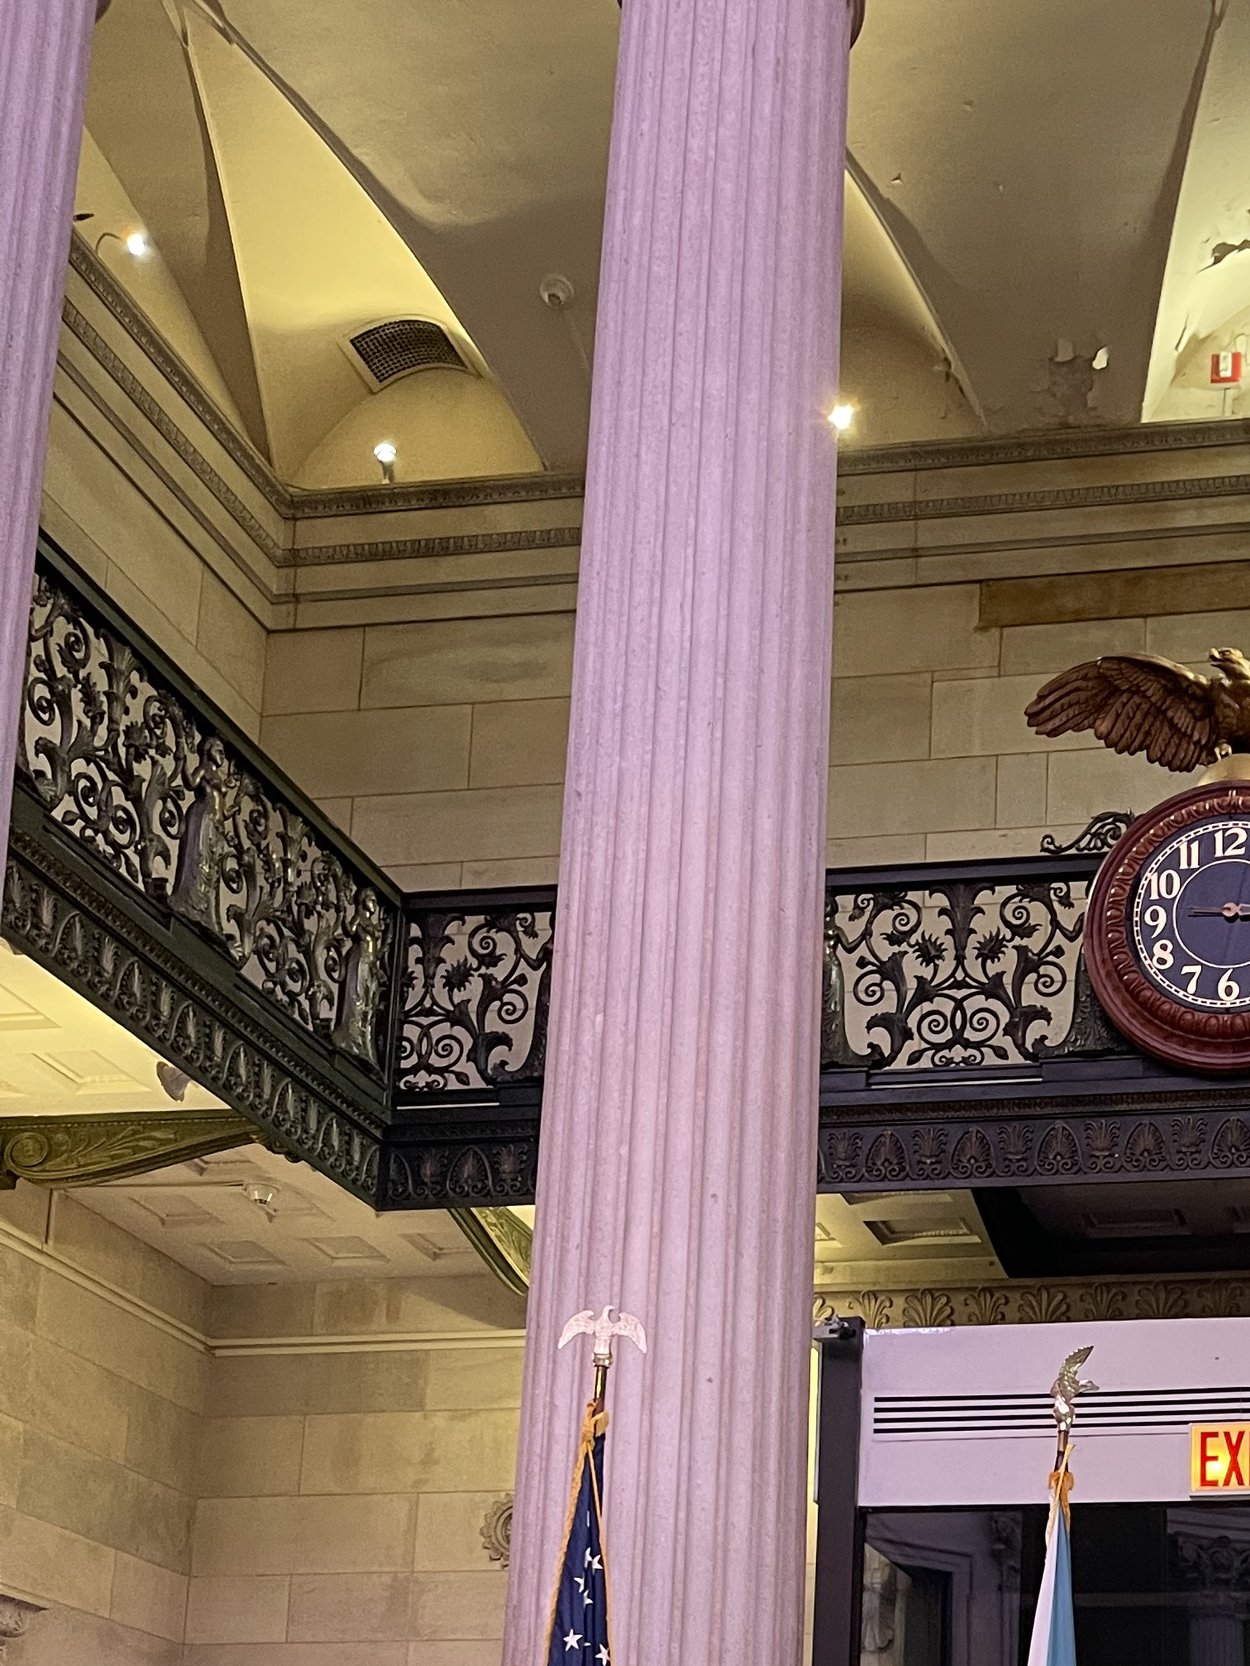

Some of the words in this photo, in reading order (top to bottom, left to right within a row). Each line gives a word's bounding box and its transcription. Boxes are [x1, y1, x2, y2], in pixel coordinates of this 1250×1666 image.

[1179, 840, 1200, 869] 11
[1214, 827, 1248, 858] 12
[1149, 869, 1180, 900] 10
[1144, 905, 1167, 938] 9
[1152, 939, 1173, 970] 8
[1180, 965, 1201, 995] 7
[1217, 969, 1240, 1000] 6
